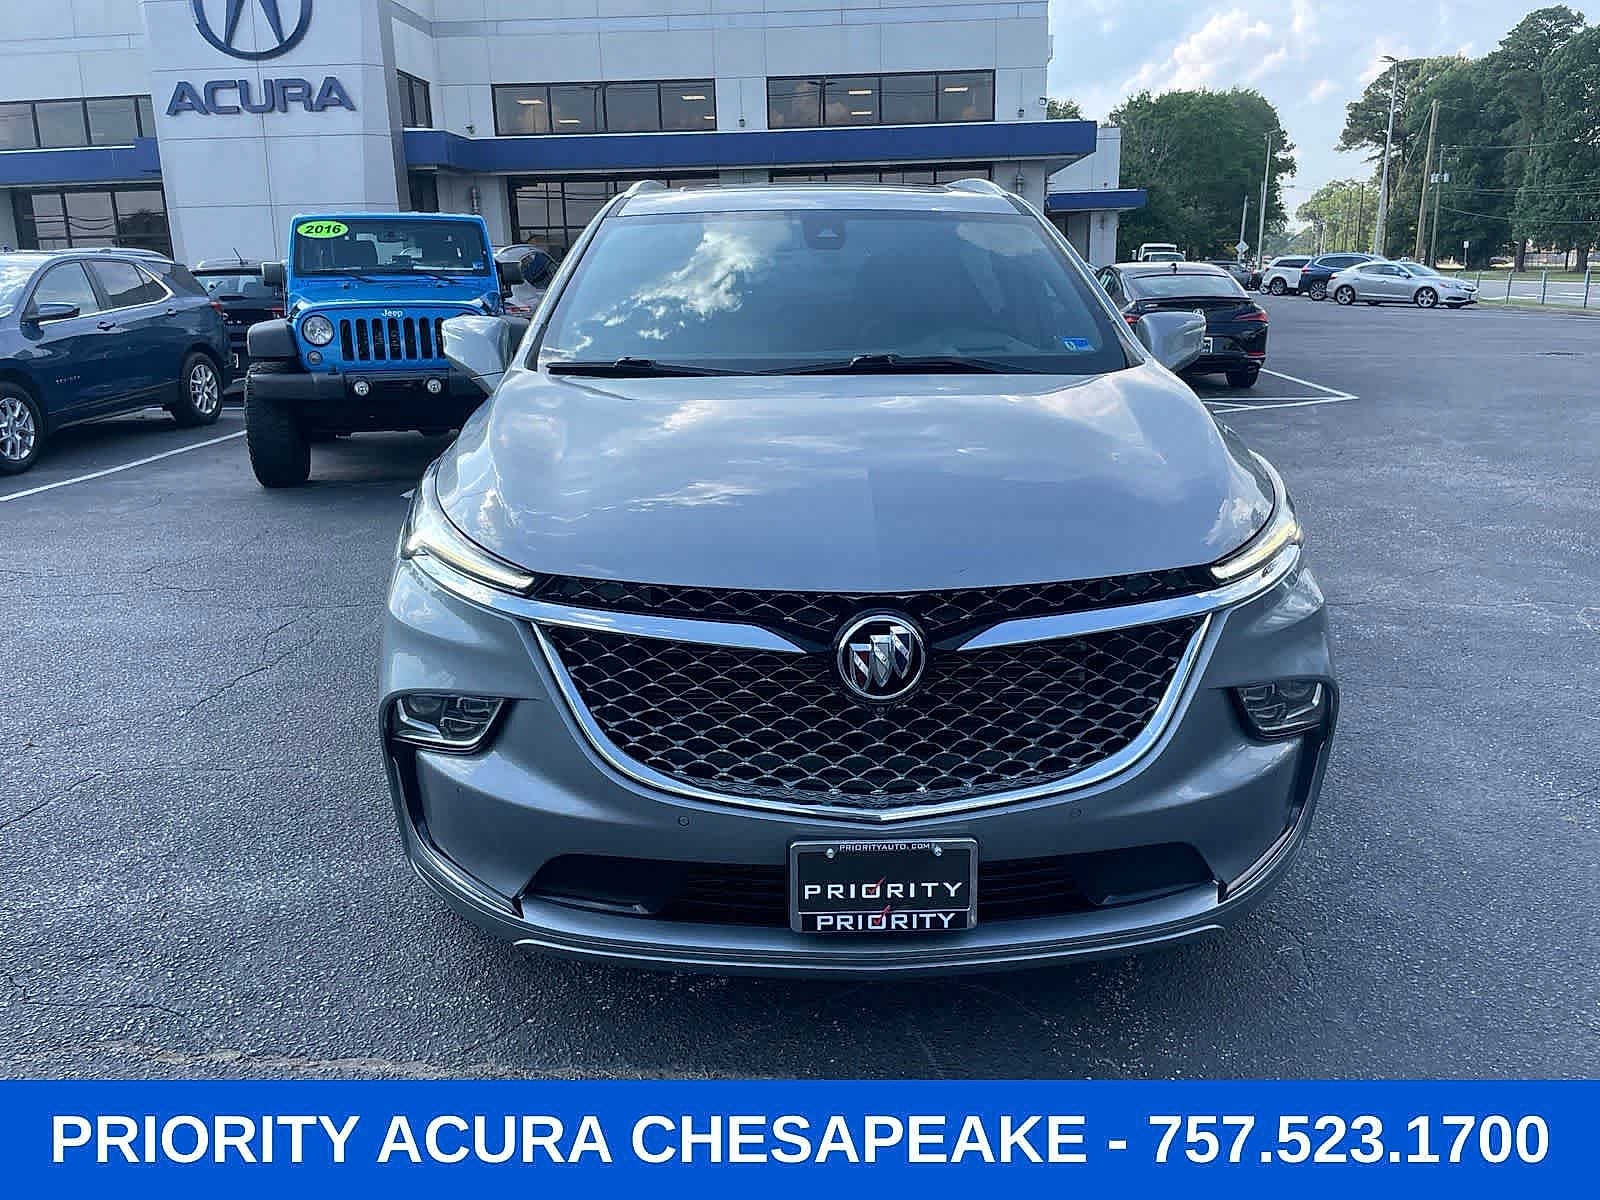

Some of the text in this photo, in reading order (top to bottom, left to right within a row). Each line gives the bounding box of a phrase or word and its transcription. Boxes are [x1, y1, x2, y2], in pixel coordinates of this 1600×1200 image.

[166, 76, 357, 116] ACURA
[304, 224, 342, 234] 2016
[382, 309, 403, 318] Jeep
[804, 881, 962, 899] PRIORITY
[816, 912, 956, 930] PRIORITY
